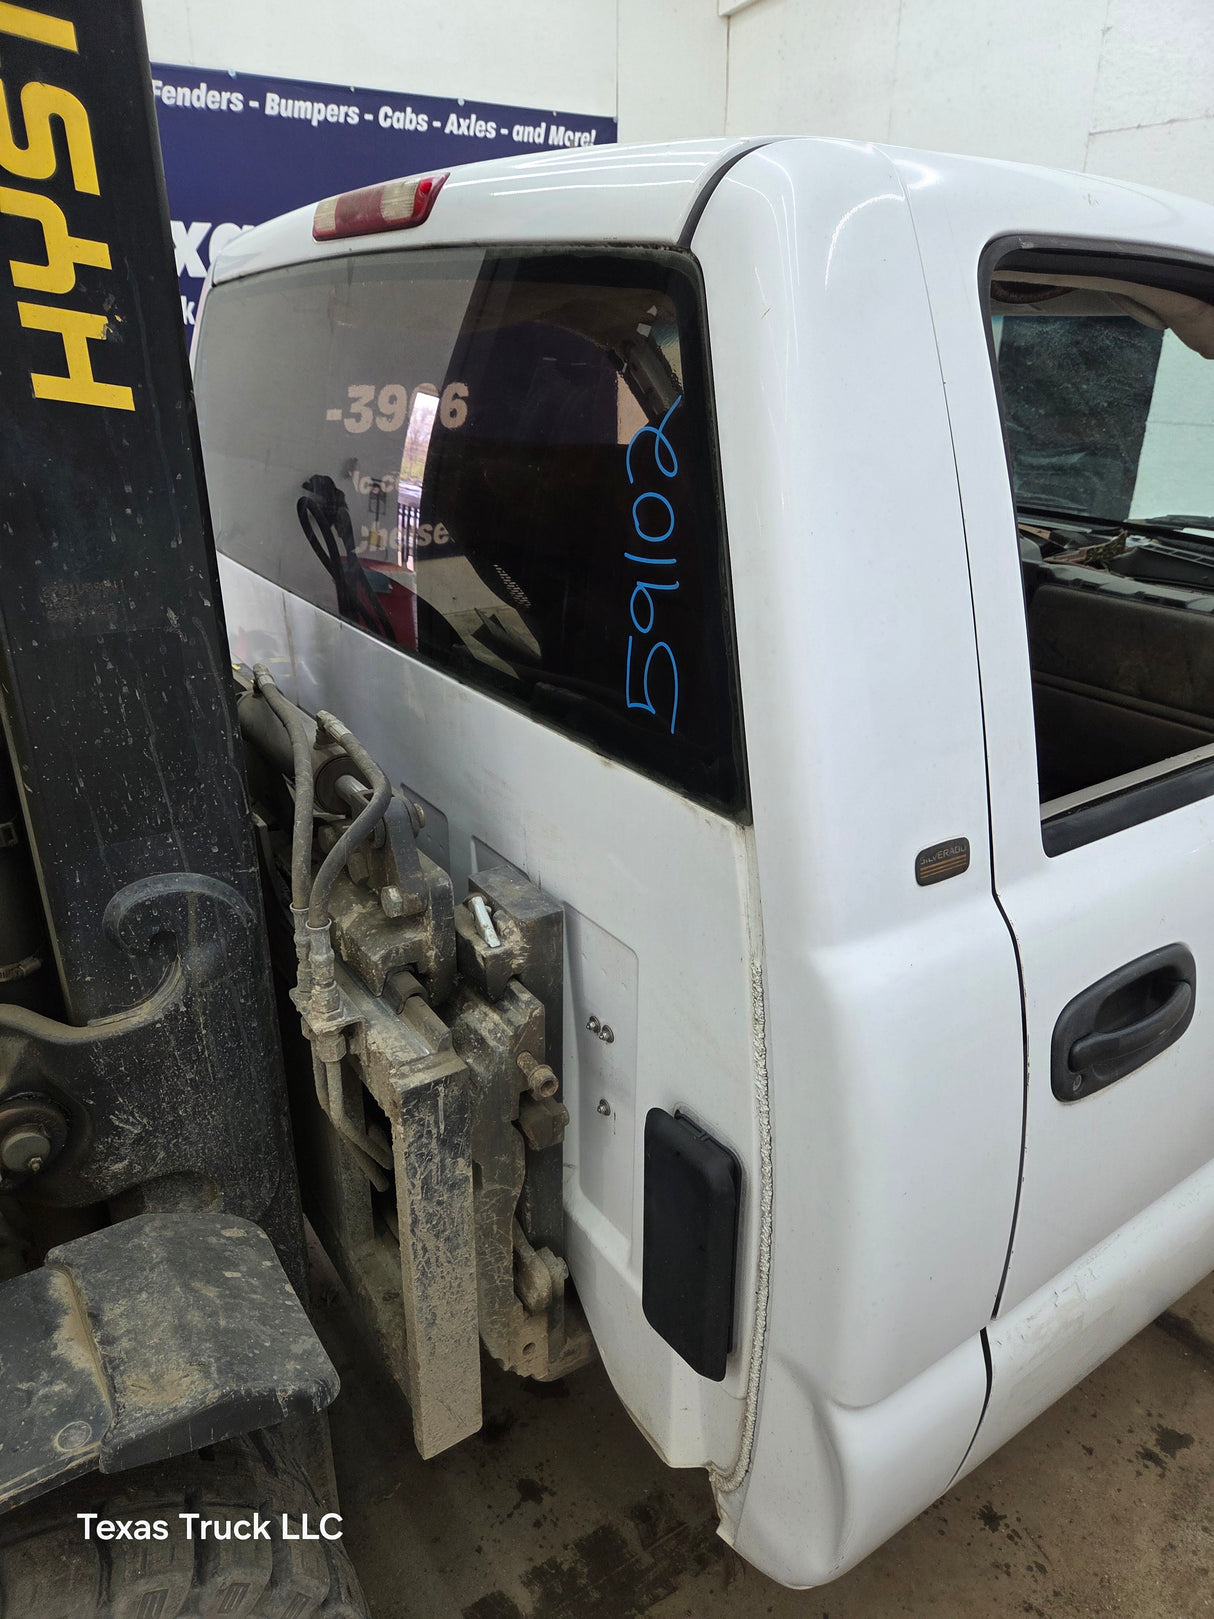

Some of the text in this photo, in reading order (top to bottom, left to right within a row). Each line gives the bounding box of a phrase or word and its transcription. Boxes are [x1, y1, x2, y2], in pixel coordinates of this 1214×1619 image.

[152, 79, 244, 113] Fenders
[265, 92, 359, 127] Bumpers
[378, 105, 428, 132] Cabs
[444, 113, 497, 139] Axles
[512, 122, 546, 144] and
[548, 125, 596, 147] More!
[624, 394, 683, 734] 59102
